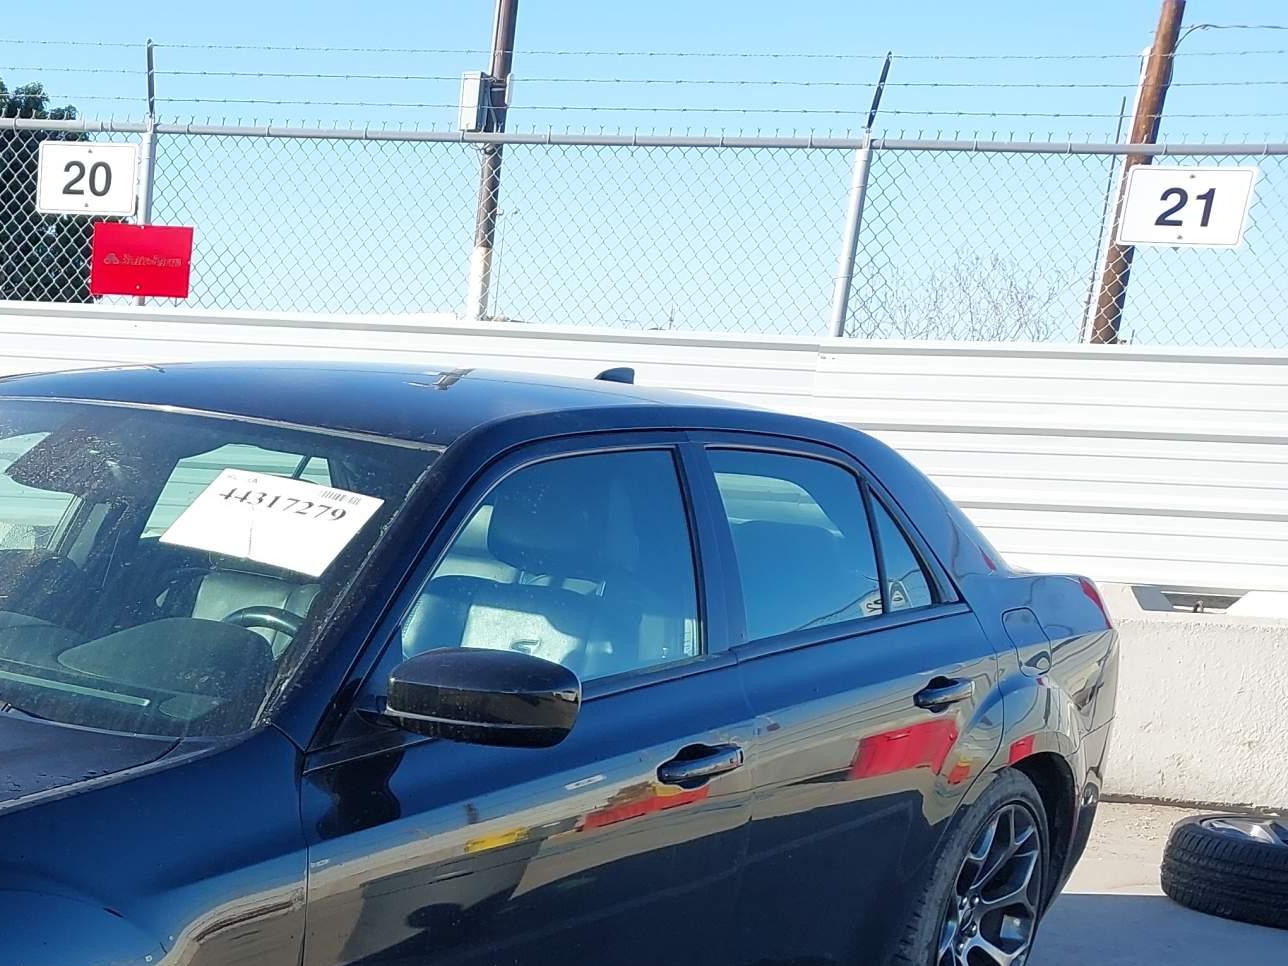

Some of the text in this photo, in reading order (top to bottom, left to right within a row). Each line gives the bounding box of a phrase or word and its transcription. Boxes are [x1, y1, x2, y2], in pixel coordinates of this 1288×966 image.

[61, 160, 113, 197] 20
[1153, 186, 1217, 227] 21
[218, 487, 348, 522] 44317279
